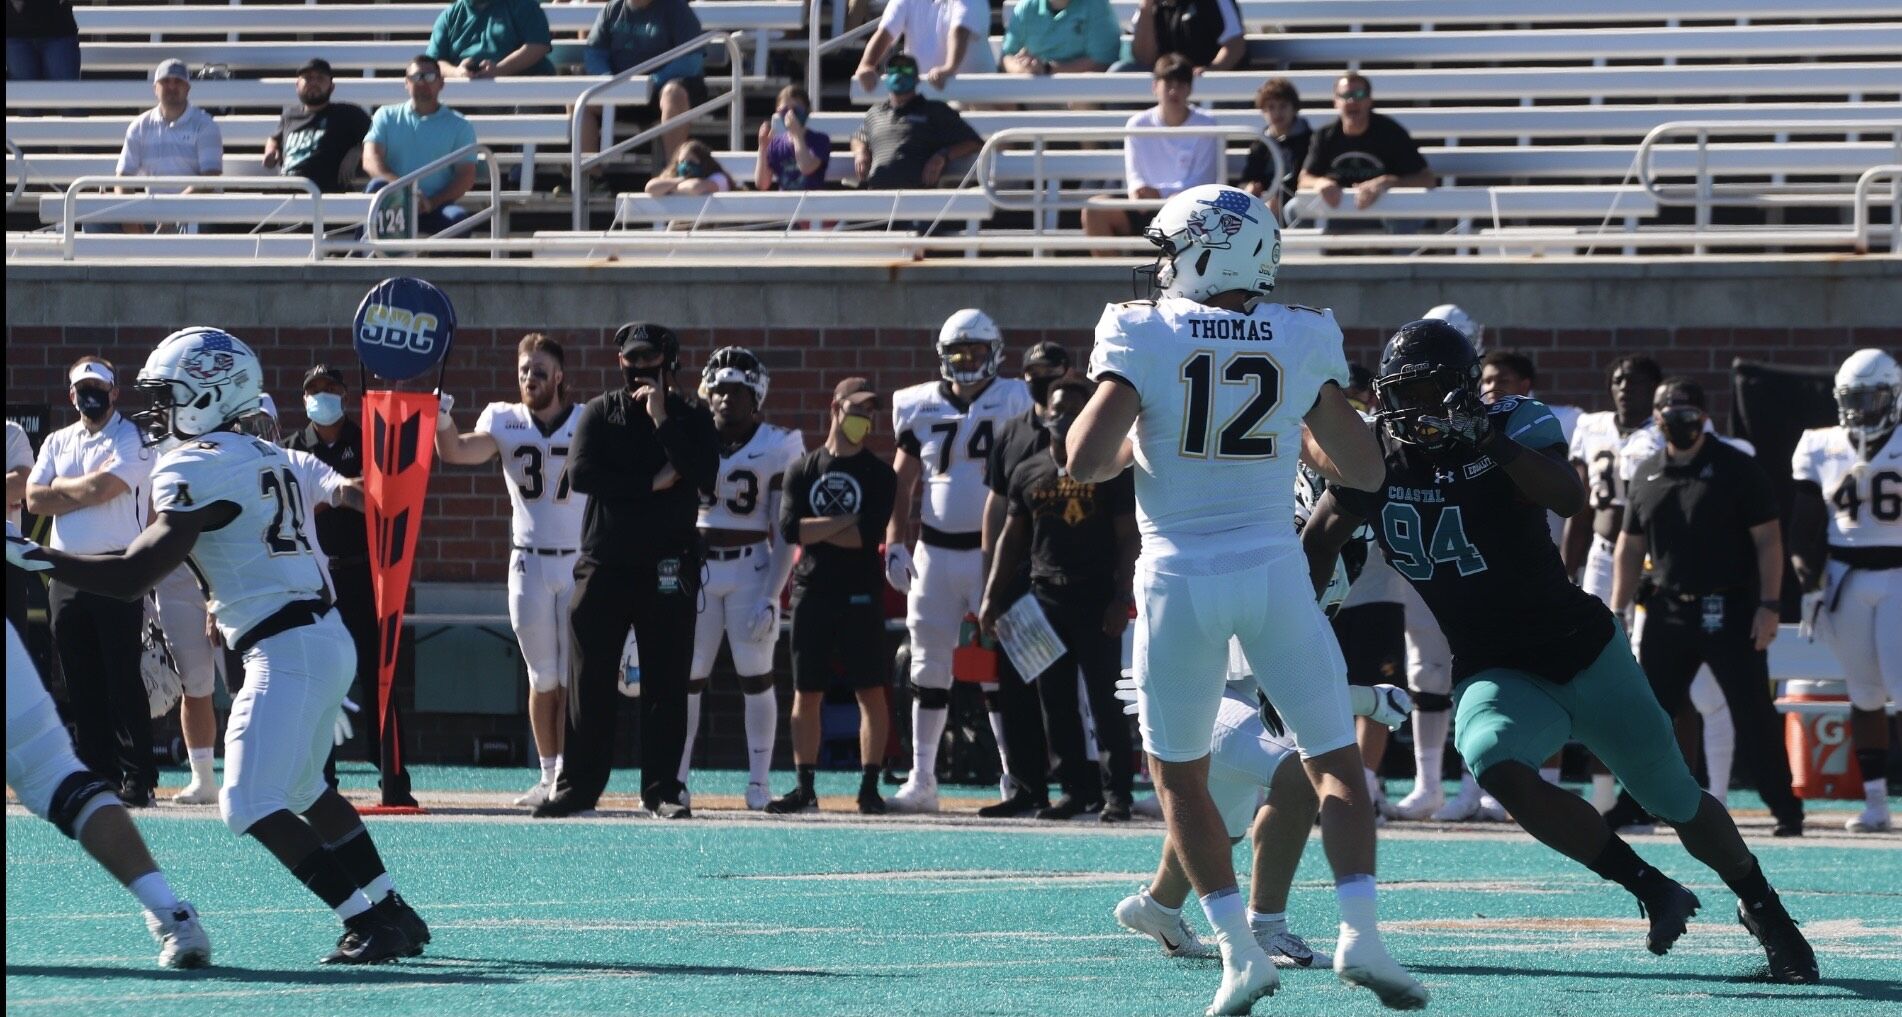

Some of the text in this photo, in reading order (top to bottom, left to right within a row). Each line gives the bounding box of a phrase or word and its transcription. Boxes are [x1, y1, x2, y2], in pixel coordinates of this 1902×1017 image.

[376, 207, 405, 234] 124
[360, 303, 438, 354] SBC
[1188, 319, 1273, 341] THOMAS
[1178, 348, 1284, 461] 12
[513, 445, 572, 504] 37
[929, 419, 994, 487] 74
[1388, 486, 1445, 502] COASTAL
[1832, 471, 1902, 523] 46
[1382, 502, 1489, 580] 94
